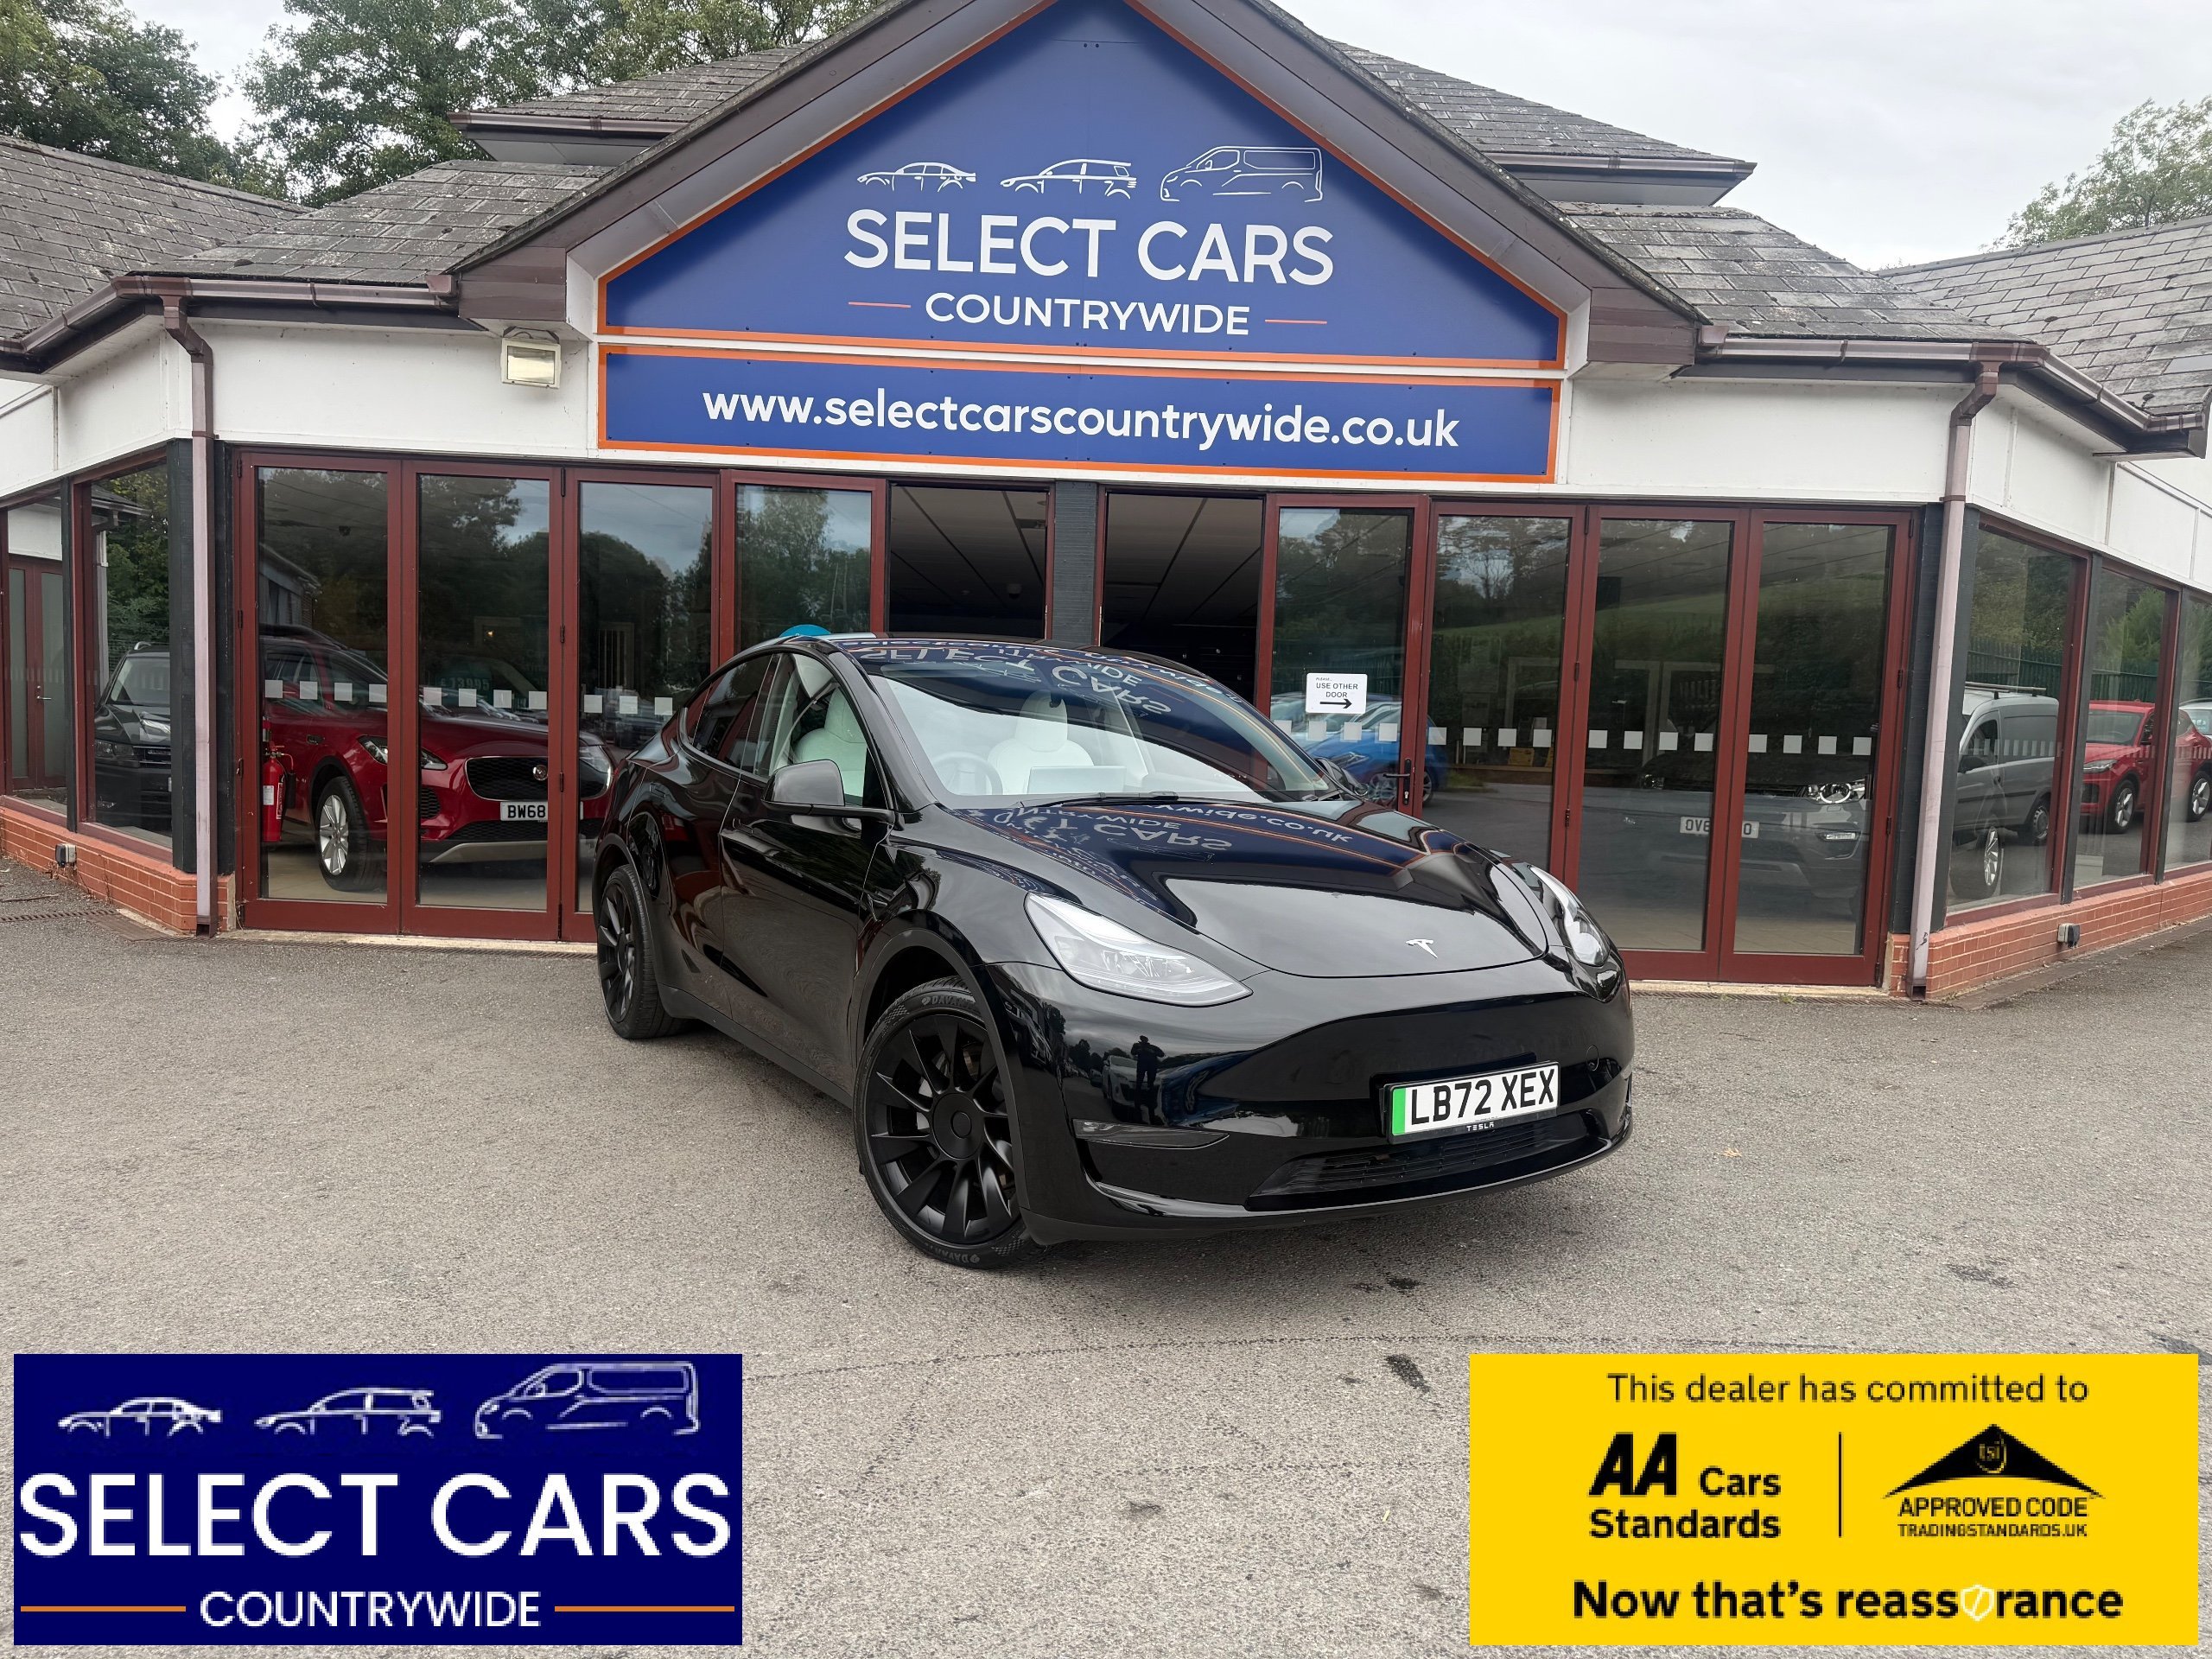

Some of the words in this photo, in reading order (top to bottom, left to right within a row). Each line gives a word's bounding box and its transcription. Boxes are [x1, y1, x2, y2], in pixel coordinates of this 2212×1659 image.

[844, 209, 1116, 277] SELECT
[1138, 221, 1333, 285] CARS
[926, 293, 1249, 335] COUNTRYWIDE
[702, 389, 1459, 450] www.selectcarscountrywide.co.uk
[507, 804, 546, 818] BW68
[1411, 1079, 1492, 1125] LB72
[1501, 1068, 1555, 1111] XEX
[1466, 1122, 1495, 1132] TESLA
